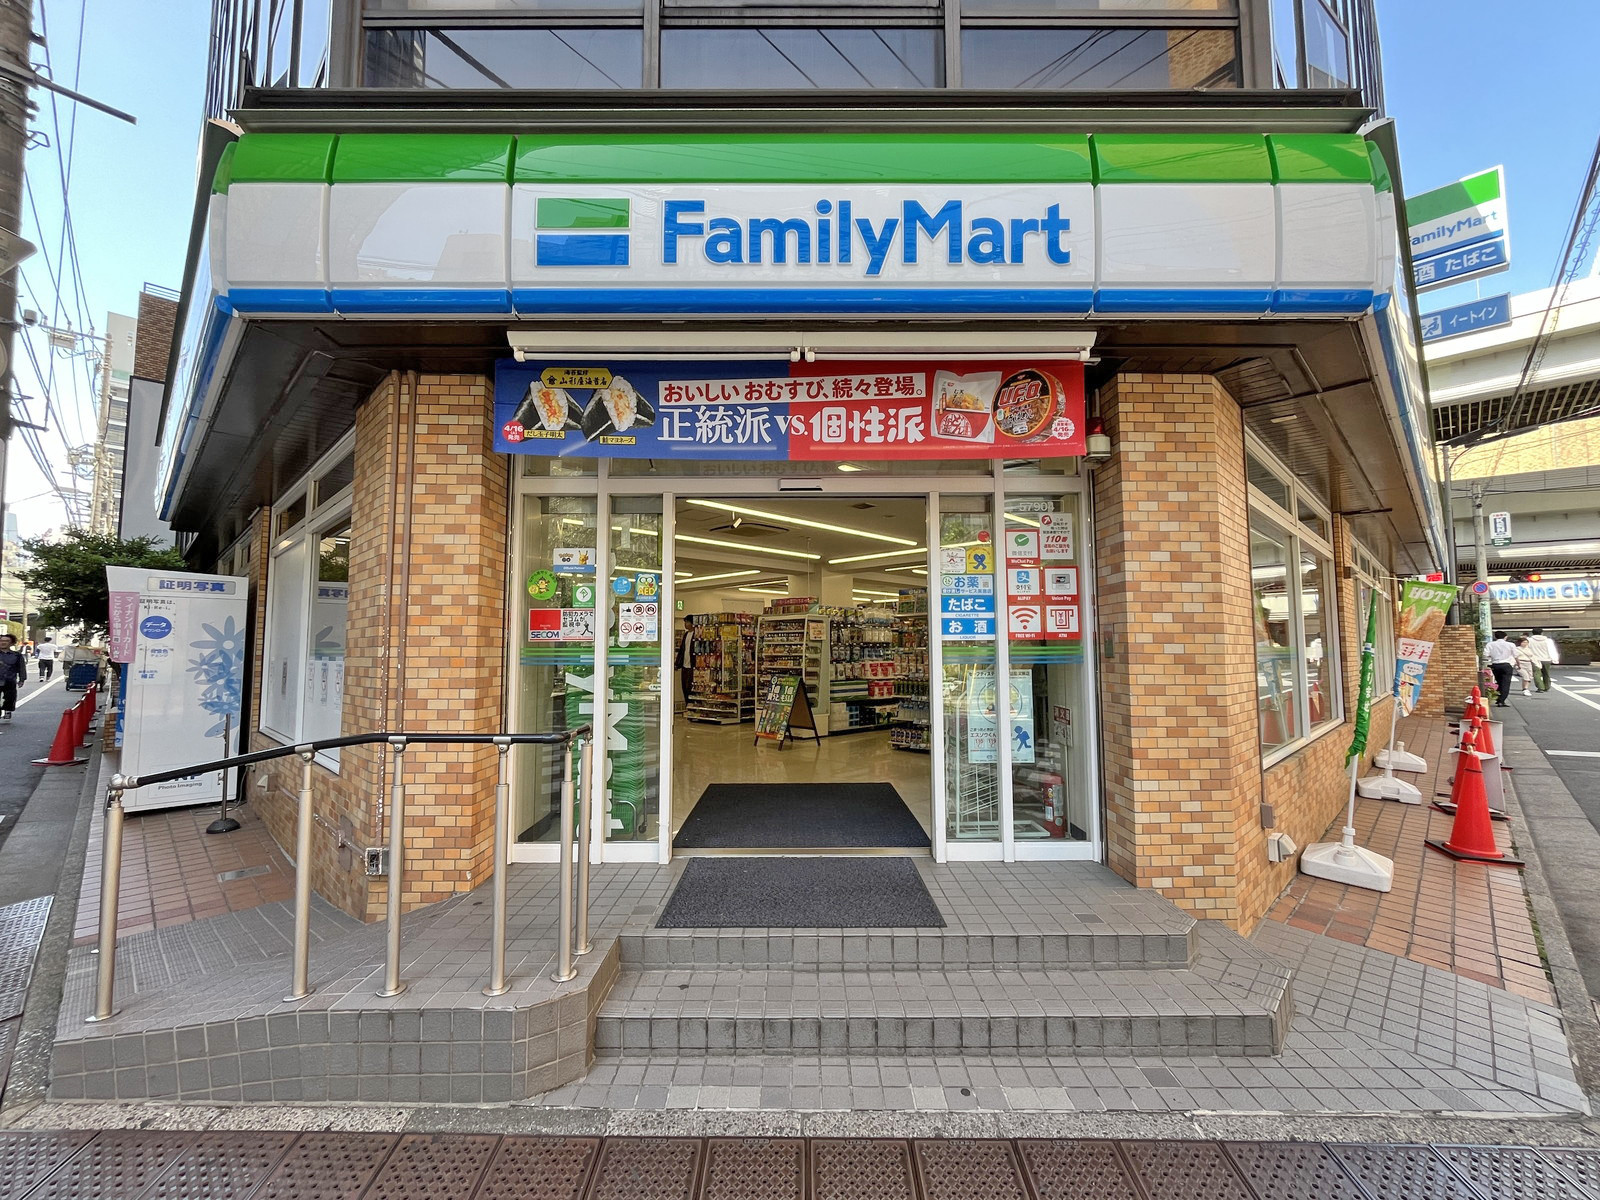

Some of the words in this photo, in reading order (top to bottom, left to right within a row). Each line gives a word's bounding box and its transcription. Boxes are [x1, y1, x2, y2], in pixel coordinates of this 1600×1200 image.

[662, 199, 1071, 277] FamilyMart
[1445, 246, 1498, 272] たばこ
[1449, 306, 1498, 329] イートイン
[657, 406, 770, 443] 正統派
[809, 406, 926, 443] 個性派
[159, 579, 226, 592] 証明写真
[638, 586, 655, 596] AED
[954, 576, 979, 588] お薬
[1408, 586, 1451, 604] HOT!
[948, 598, 986, 611] たばこ
[123, 596, 134, 656] マイナンバーカード
[949, 620, 988, 633] お酒
